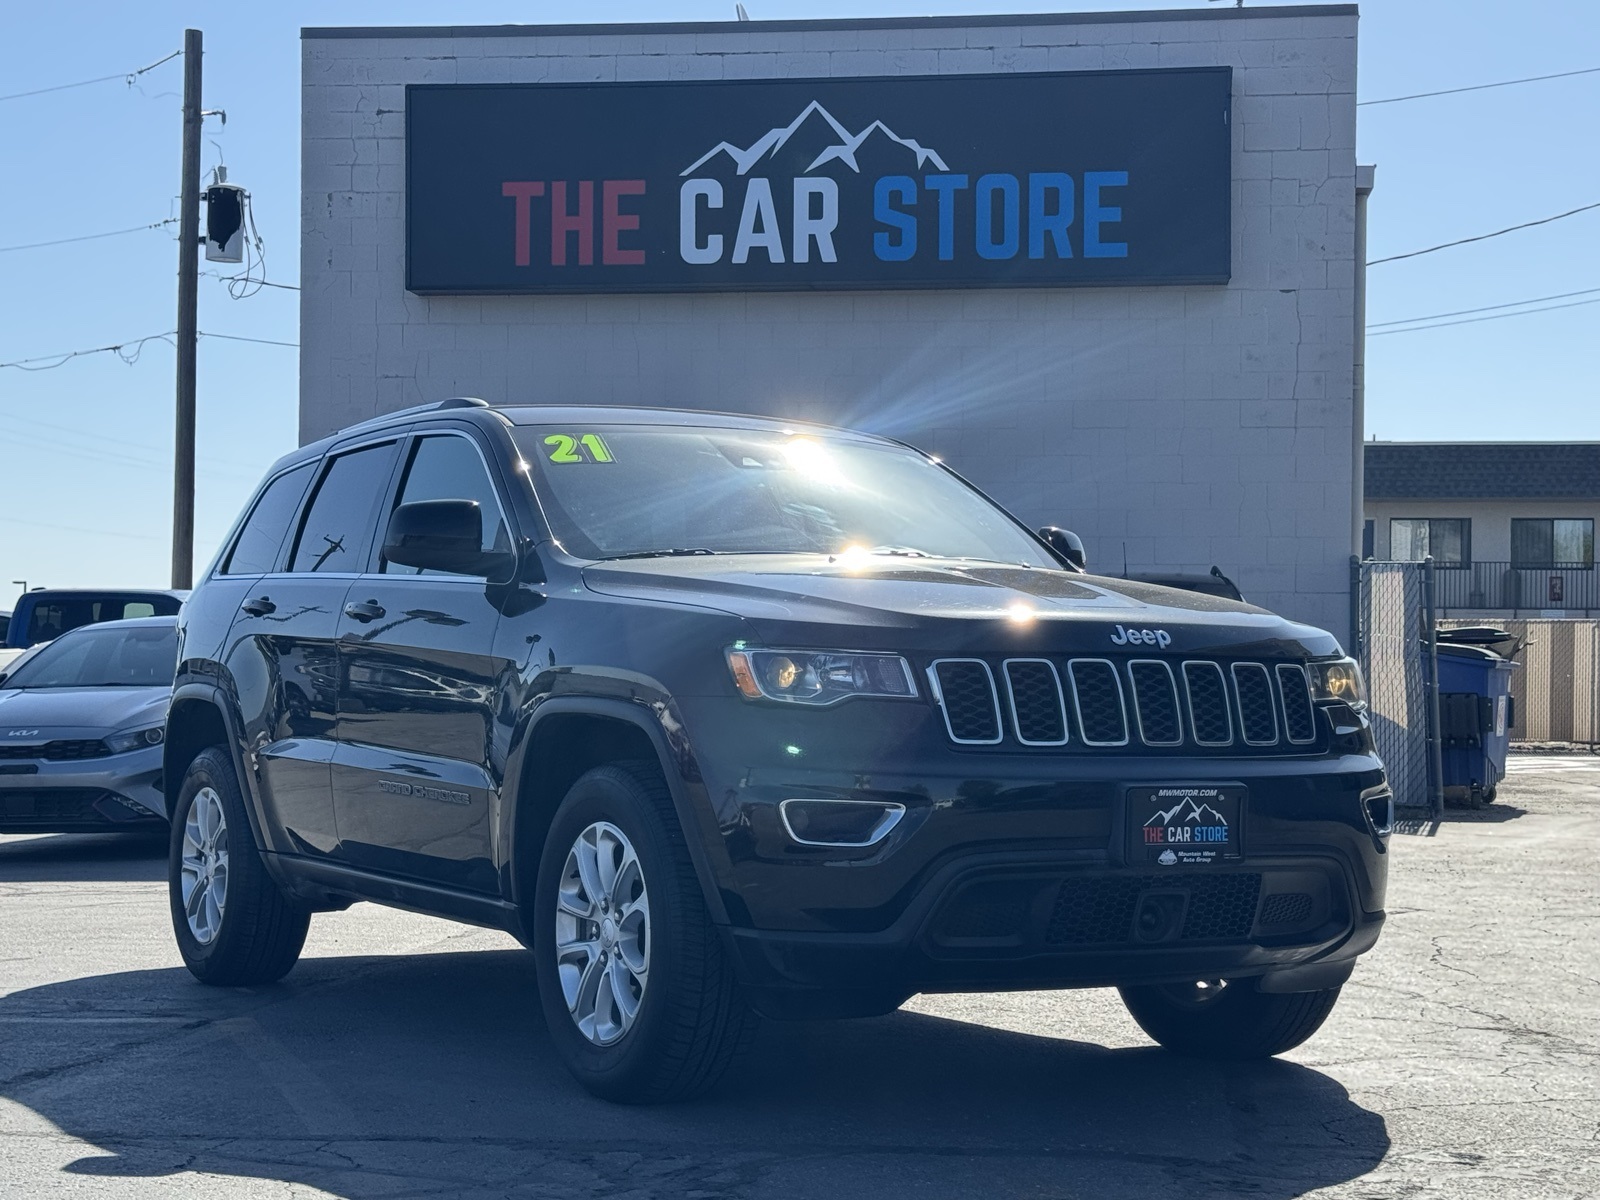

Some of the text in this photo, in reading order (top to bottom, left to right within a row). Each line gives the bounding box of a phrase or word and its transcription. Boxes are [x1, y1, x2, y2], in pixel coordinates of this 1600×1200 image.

[502, 171, 1130, 267] THE CAR STORE
[544, 434, 613, 463] 21
[1110, 624, 1172, 650] Jeep
[1158, 789, 1218, 797] MWMOTOR.COM
[1143, 826, 1229, 842] THE CAR STORE
